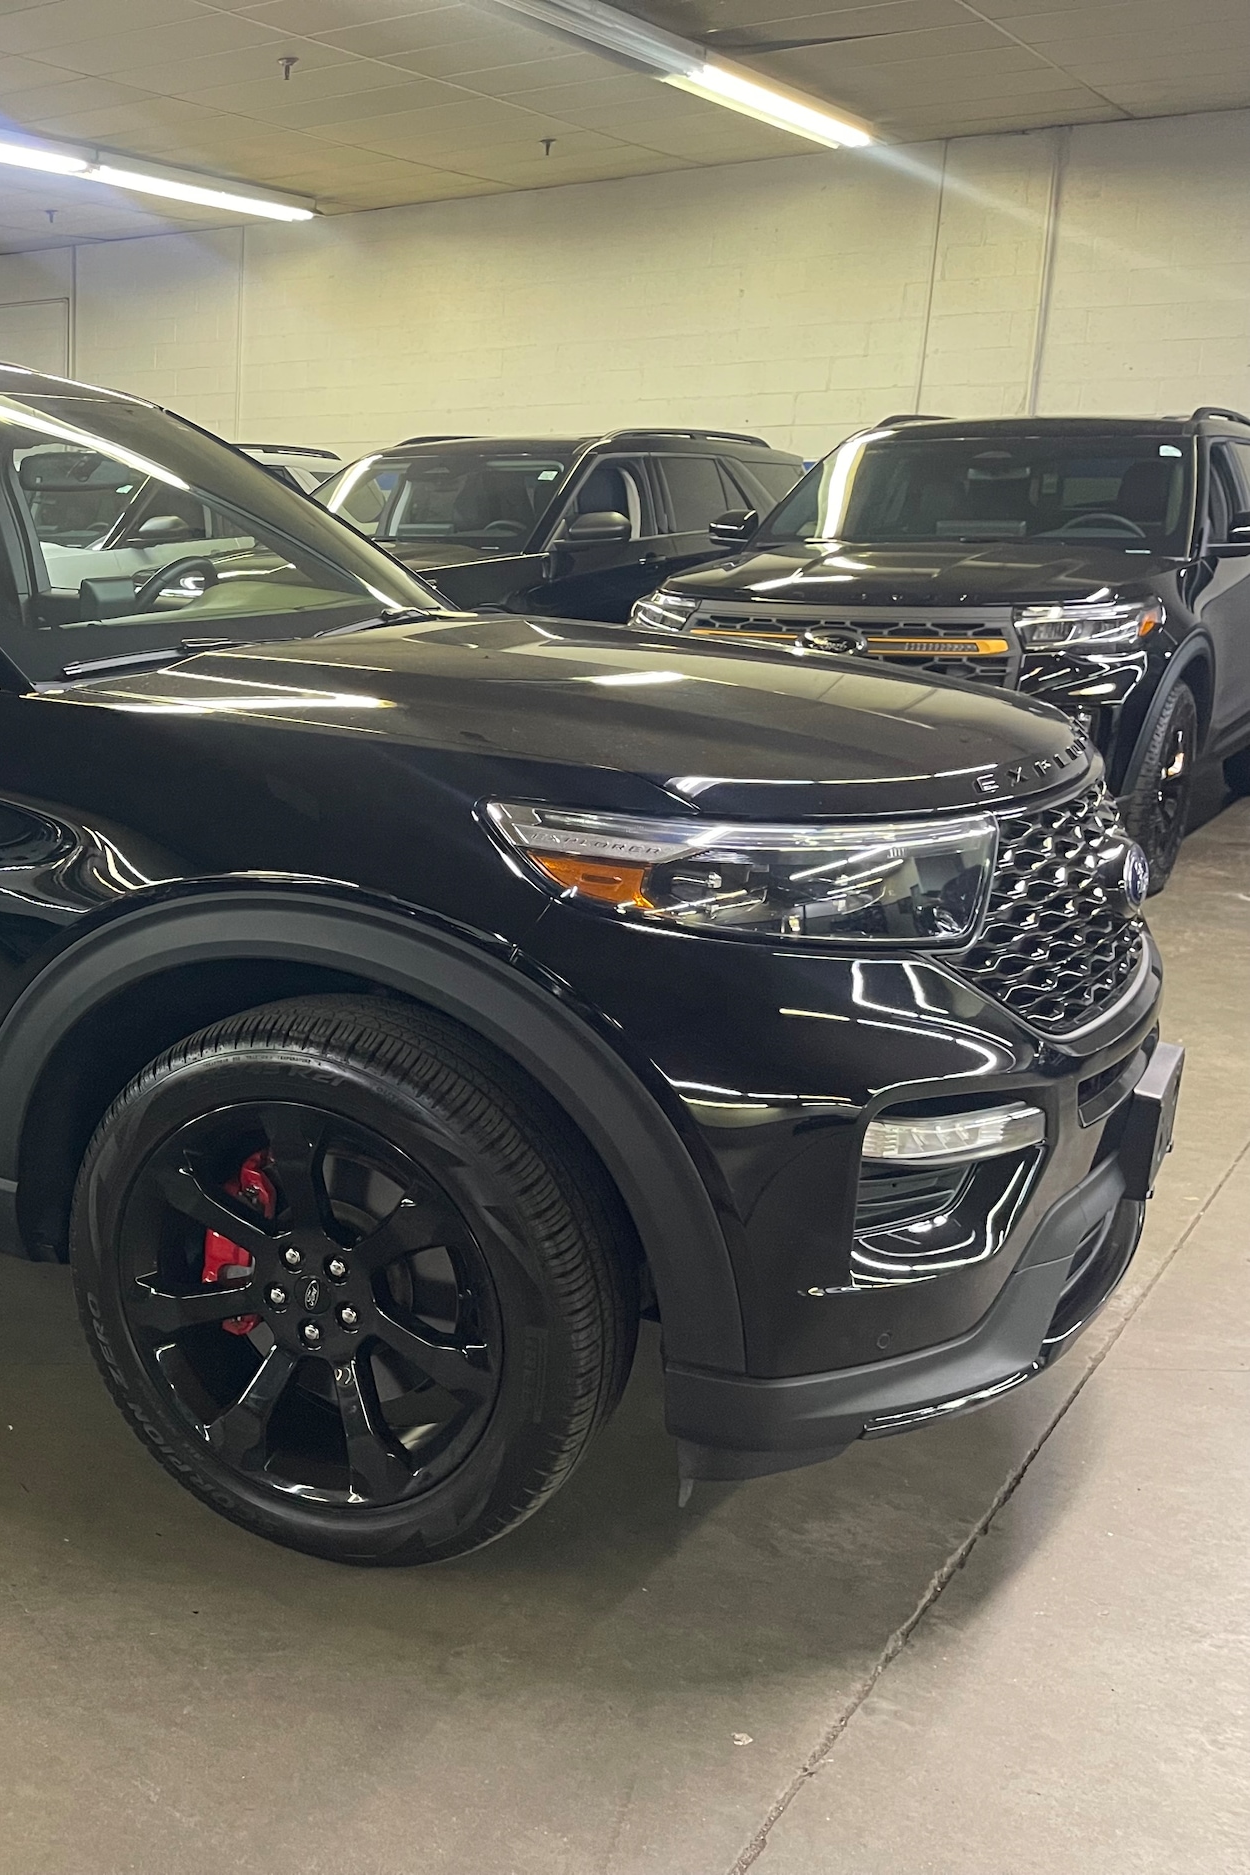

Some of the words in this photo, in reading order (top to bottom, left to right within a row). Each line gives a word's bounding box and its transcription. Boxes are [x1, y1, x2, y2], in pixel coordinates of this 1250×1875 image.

[972, 716, 1090, 794] EXPLO
[530, 832, 662, 855] EXPLORER
[287, 1064, 347, 1088] R21
[86, 1291, 130, 1390] ZERO
